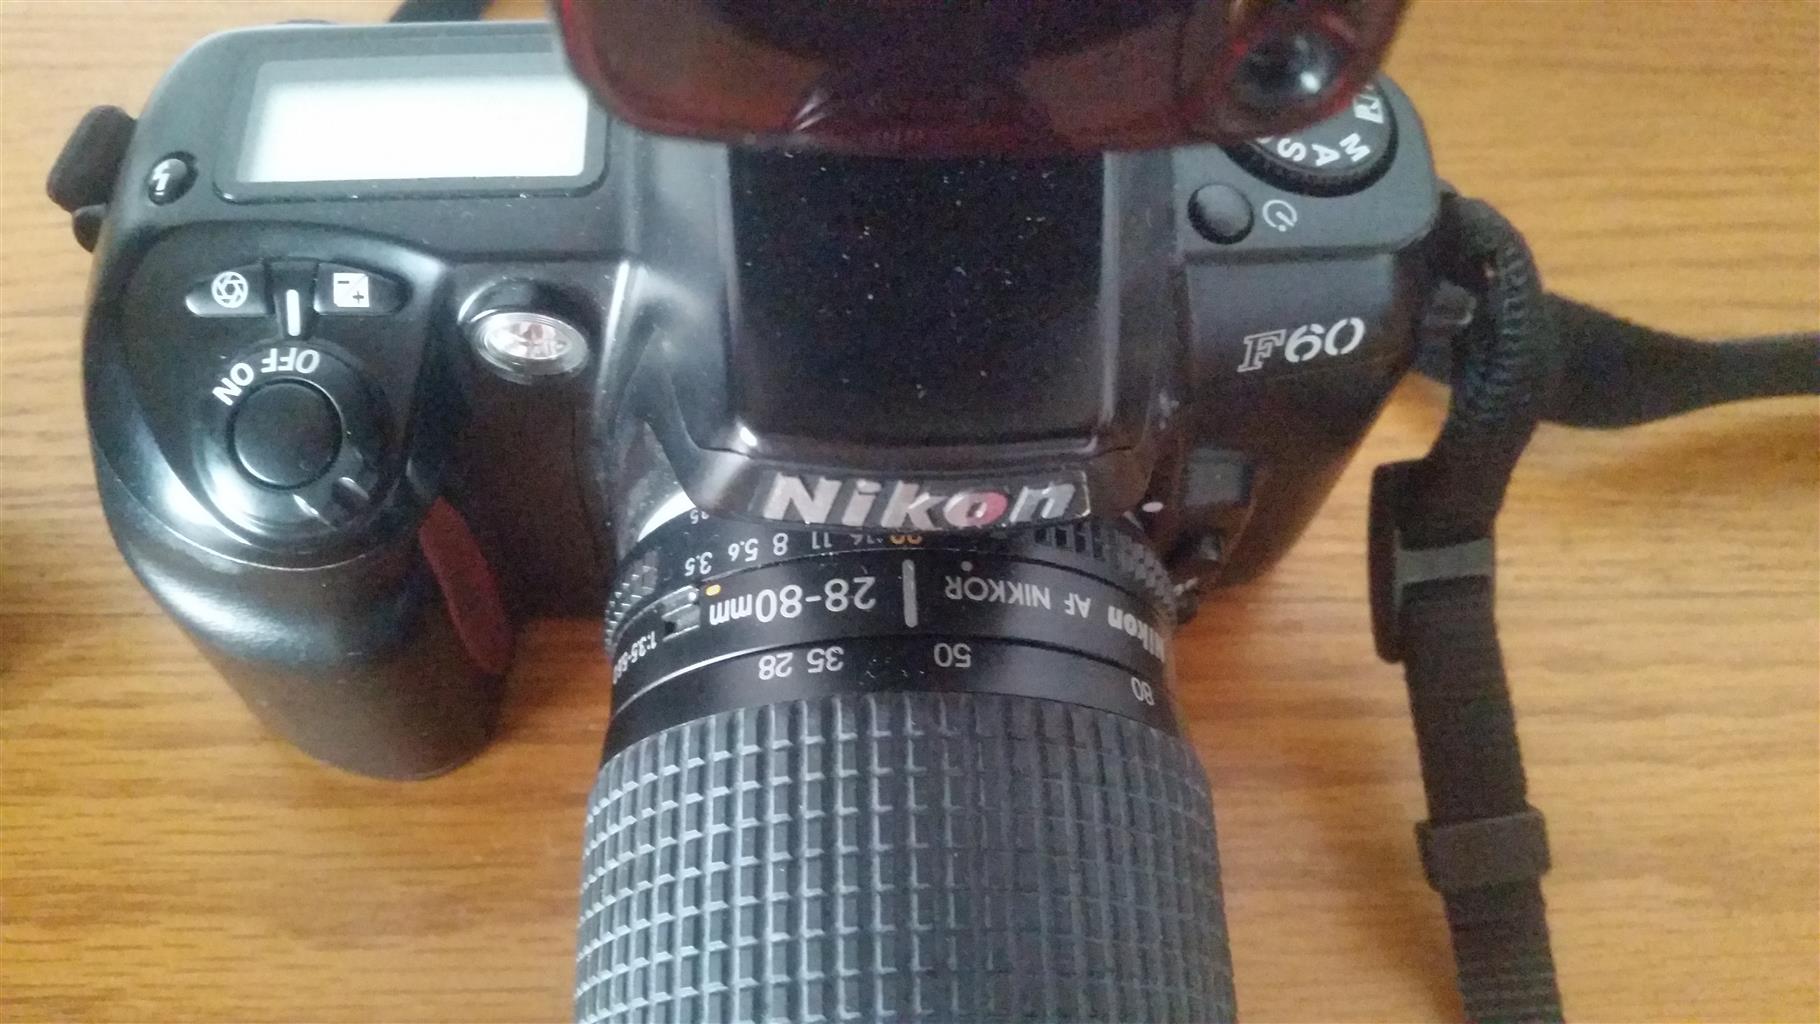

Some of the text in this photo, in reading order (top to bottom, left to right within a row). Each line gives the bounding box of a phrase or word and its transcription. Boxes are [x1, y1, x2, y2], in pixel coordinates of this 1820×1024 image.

[1277, 138, 1307, 162] S
[1311, 143, 1340, 167] A
[1339, 132, 1371, 162] M
[1237, 317, 1366, 373] F60
[212, 347, 321, 406] OFF ON
[762, 472, 1076, 531] Nikon
[727, 537, 760, 562] 5.6
[772, 532, 789, 556] 8
[684, 551, 713, 577] 3.5
[708, 576, 877, 626] 28-80mm
[944, 574, 1051, 610] NIKKOR
[1064, 592, 1092, 618] AF
[758, 642, 1156, 706] 80 50 35 28
